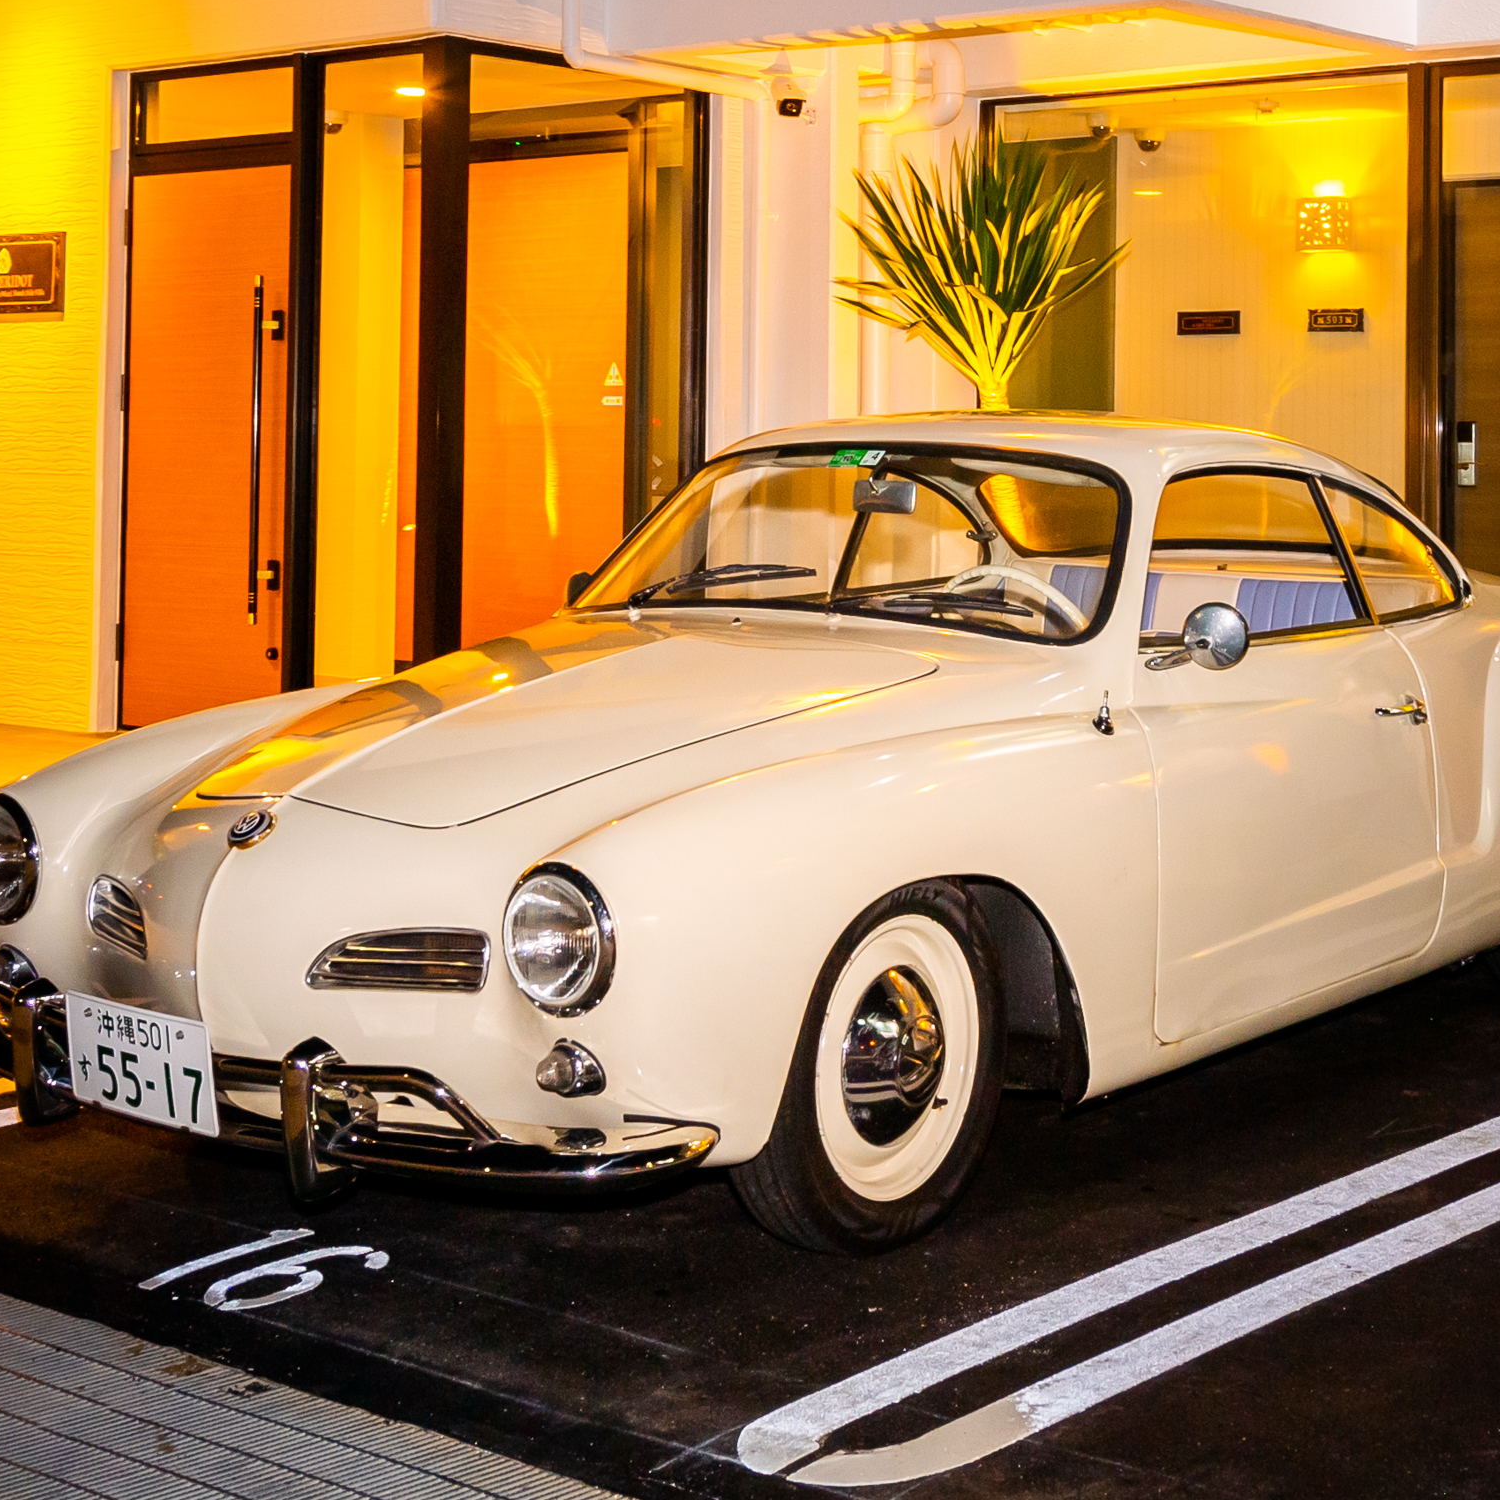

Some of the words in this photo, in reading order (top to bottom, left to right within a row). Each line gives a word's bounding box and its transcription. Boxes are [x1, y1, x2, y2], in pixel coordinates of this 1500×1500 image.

[78, 1053, 92, 1082] す
[96, 1044, 203, 1124] 55-17
[137, 1227, 390, 1313] 16
